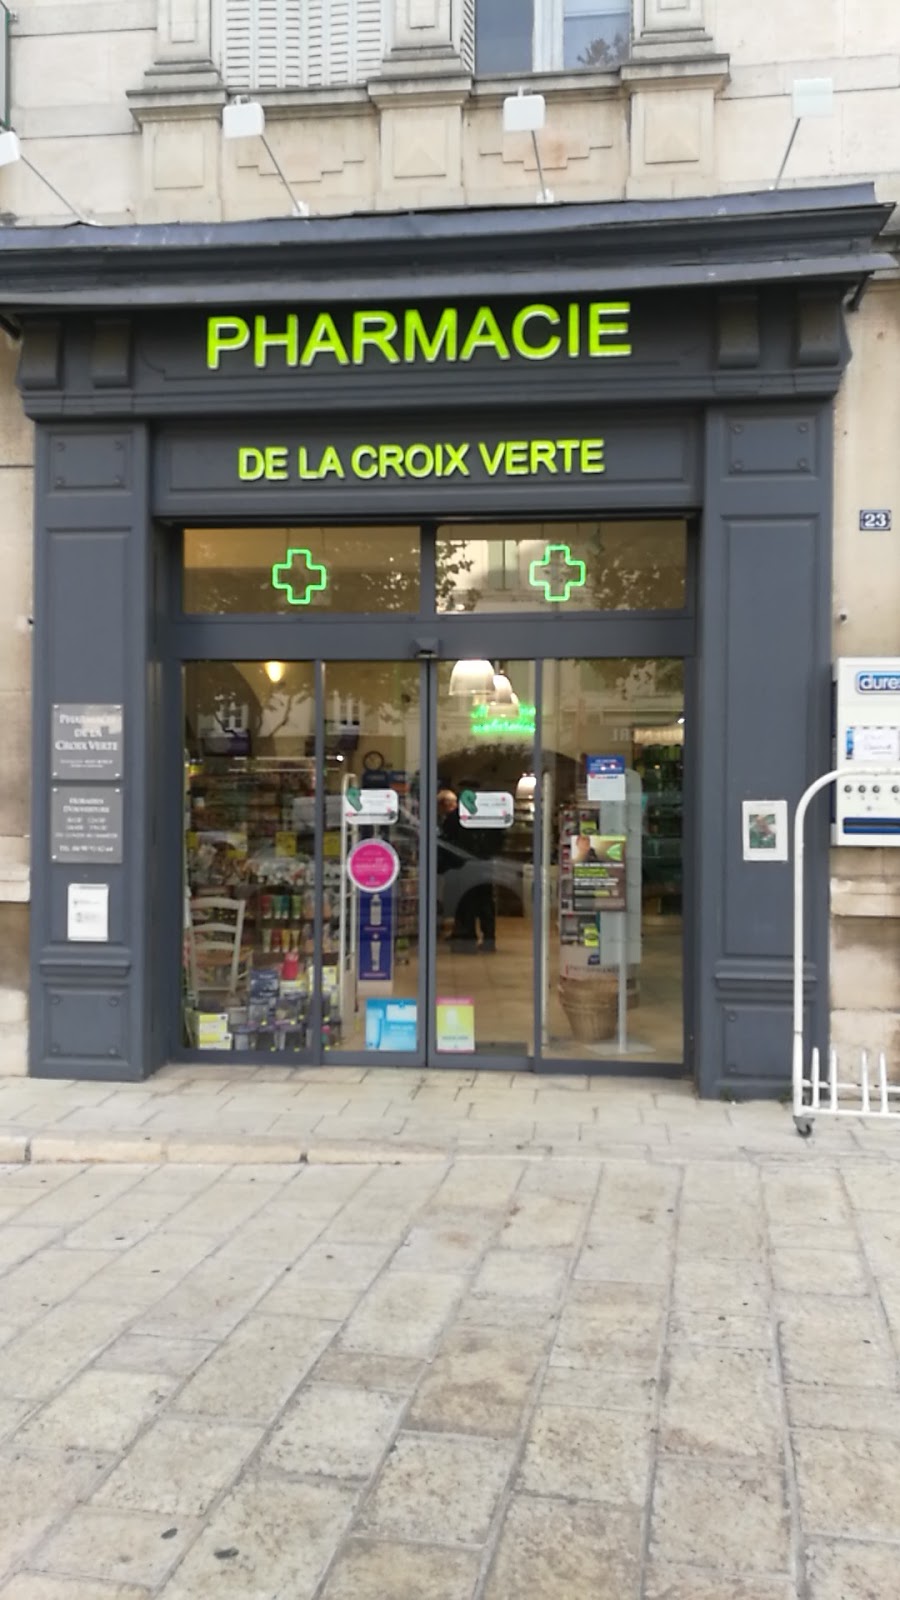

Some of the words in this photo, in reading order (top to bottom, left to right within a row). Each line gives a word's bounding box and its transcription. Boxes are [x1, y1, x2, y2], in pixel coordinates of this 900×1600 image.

[207, 302, 631, 369] PHARMACIE
[238, 446, 288, 481] DE
[299, 445, 345, 480] LA
[351, 443, 470, 479] CROIX
[479, 438, 605, 477] VERTE
[864, 513, 887, 527] 23
[860, 674, 900, 690] dure
